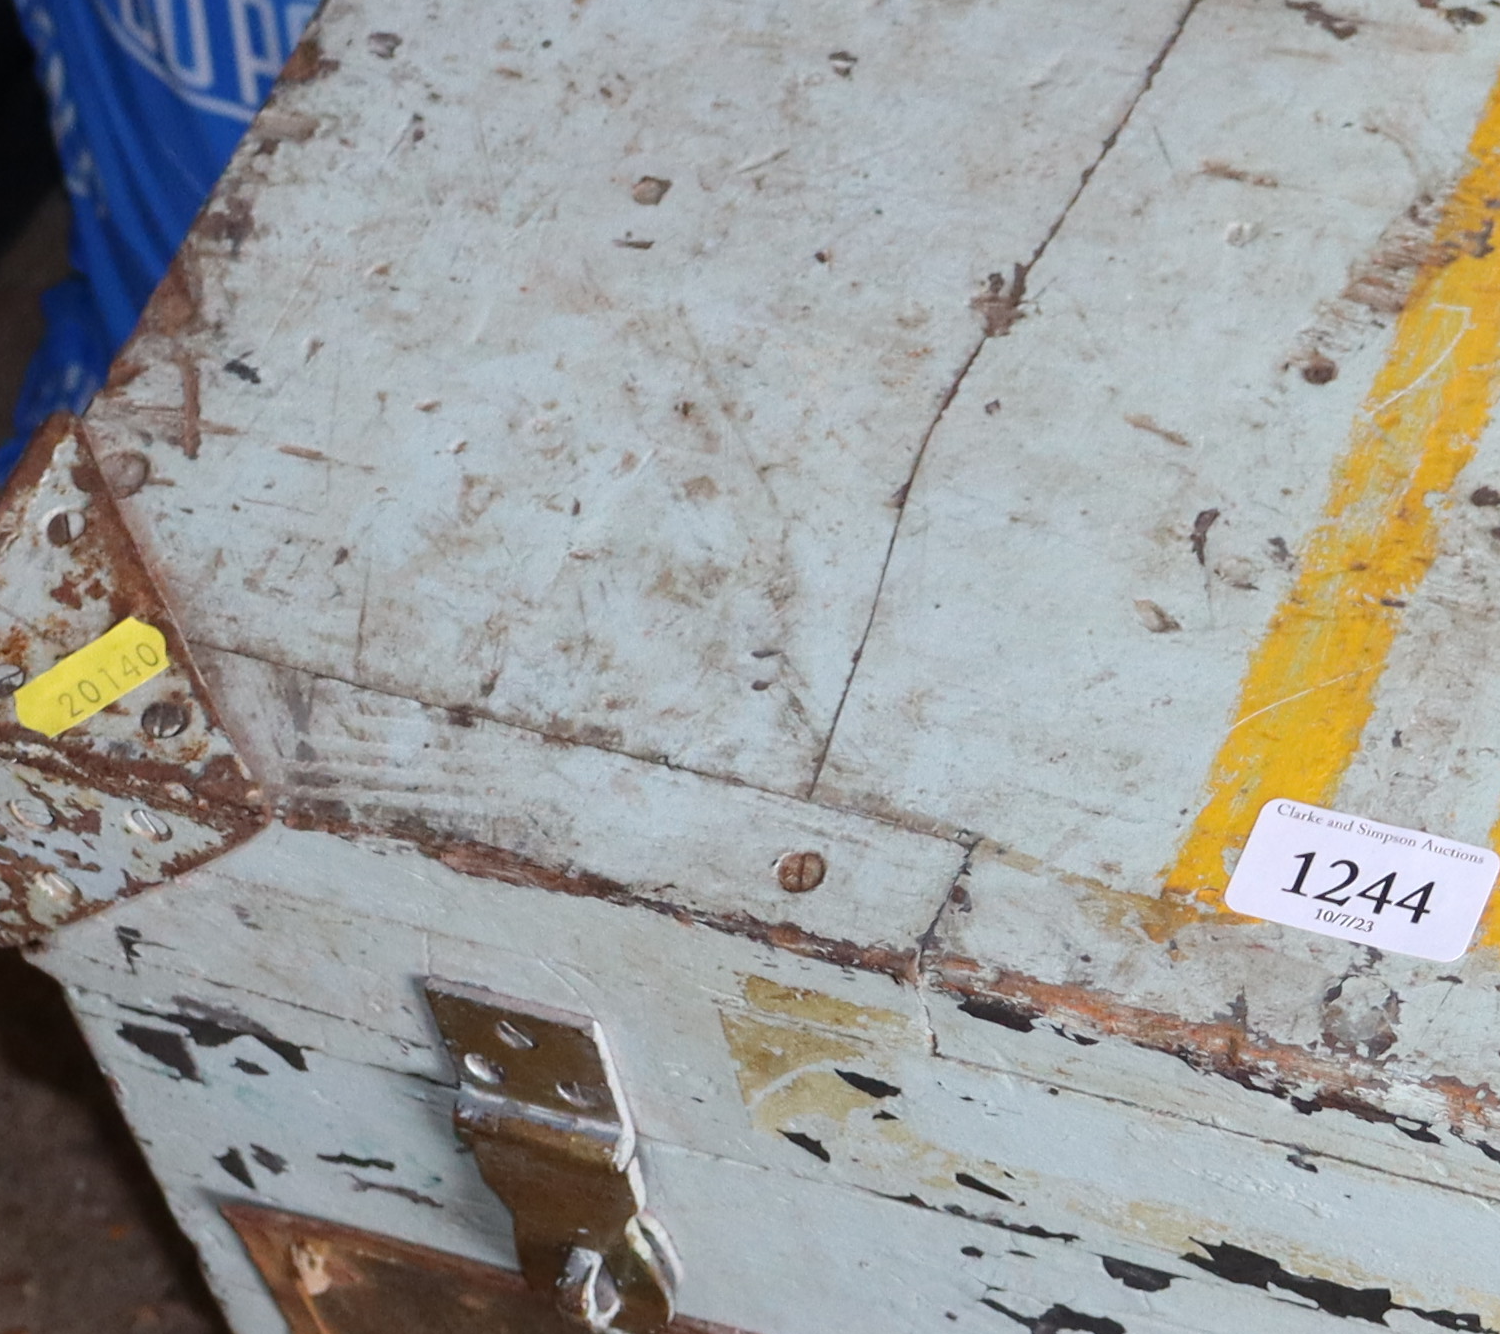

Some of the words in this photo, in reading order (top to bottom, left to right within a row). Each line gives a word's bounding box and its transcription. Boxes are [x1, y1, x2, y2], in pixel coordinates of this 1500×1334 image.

[1276, 803, 1324, 827] Clarke
[1327, 816, 1354, 834] and
[1356, 822, 1417, 848] Simpson
[1421, 839, 1485, 865] Auctions
[1281, 850, 1435, 924] 1244
[1314, 907, 1375, 934] 10/7/23
